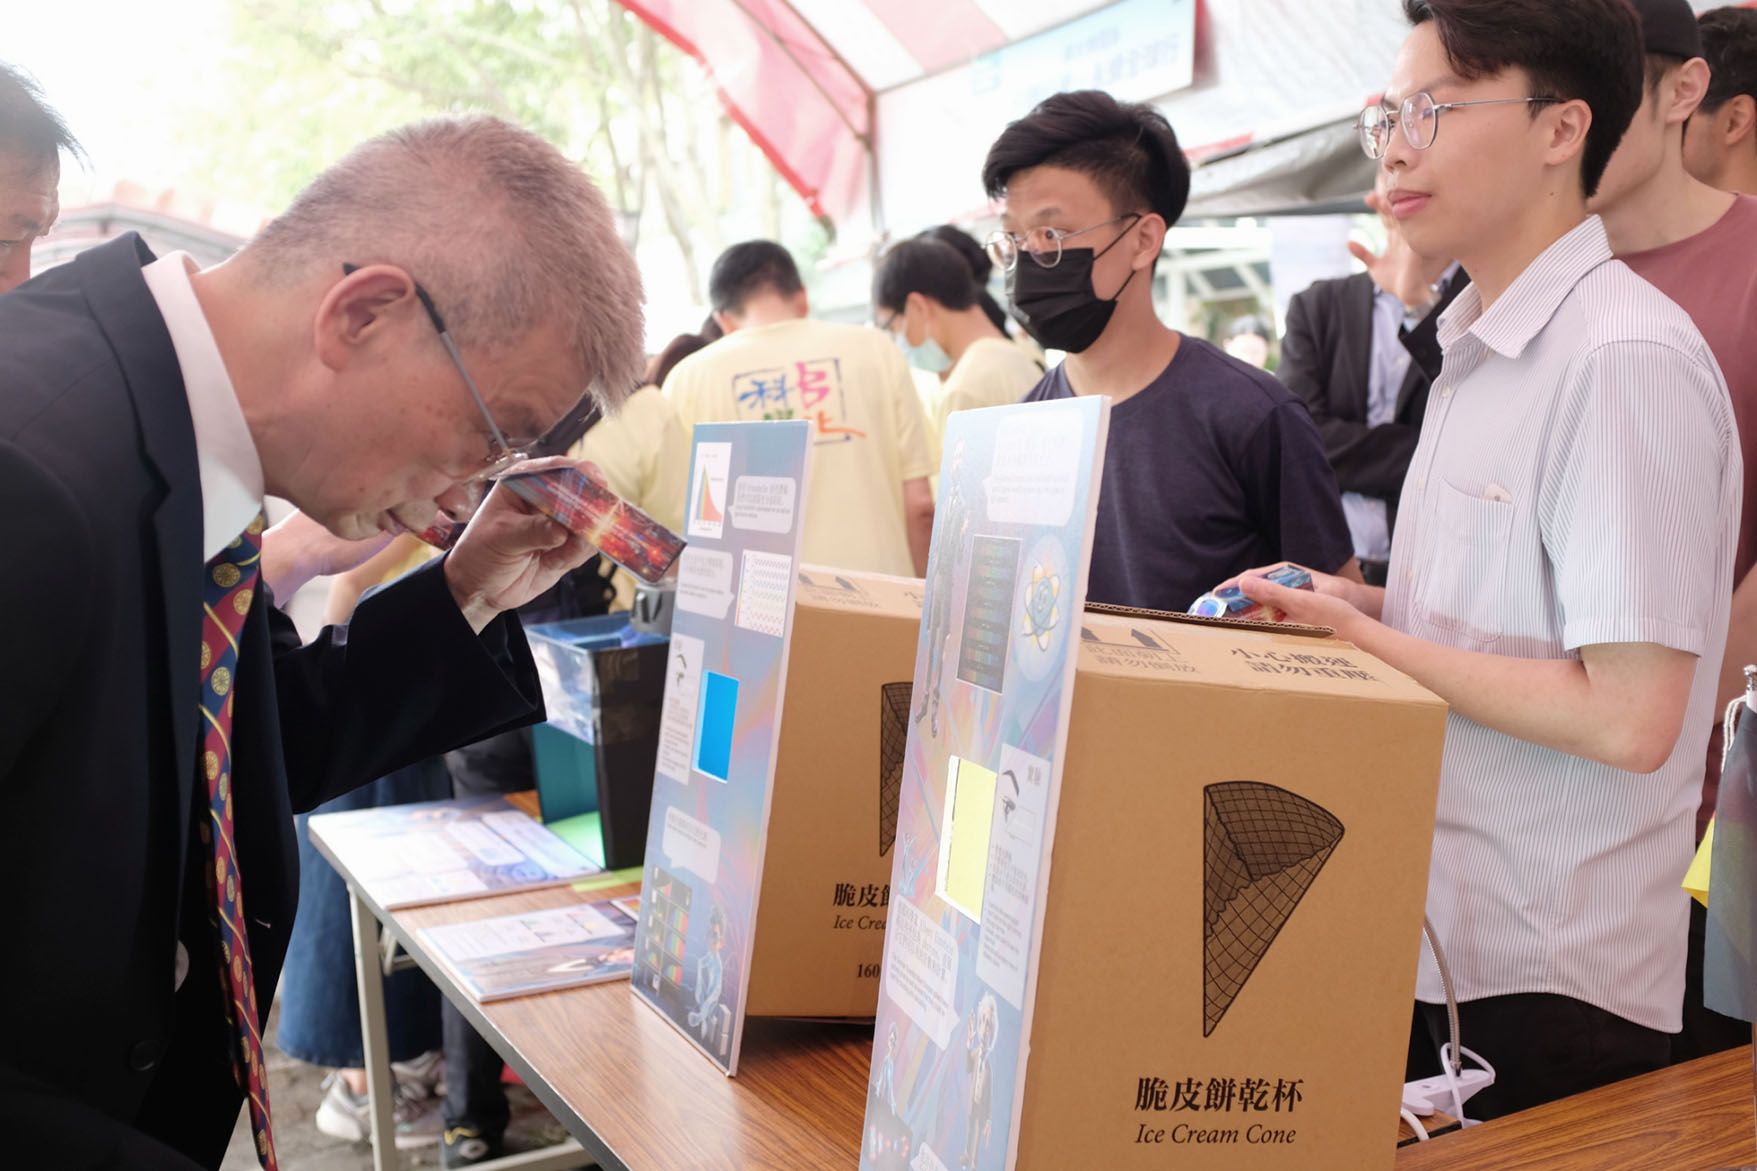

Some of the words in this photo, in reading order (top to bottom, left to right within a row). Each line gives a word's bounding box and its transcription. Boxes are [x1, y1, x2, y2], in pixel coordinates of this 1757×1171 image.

[833, 915, 854, 930] Ice
[1135, 1077, 1304, 1112] 脆皮餅乾杯
[1136, 1123, 1165, 1144] Ice
[1171, 1123, 1239, 1144] Cream
[1246, 1123, 1297, 1144] Cone
